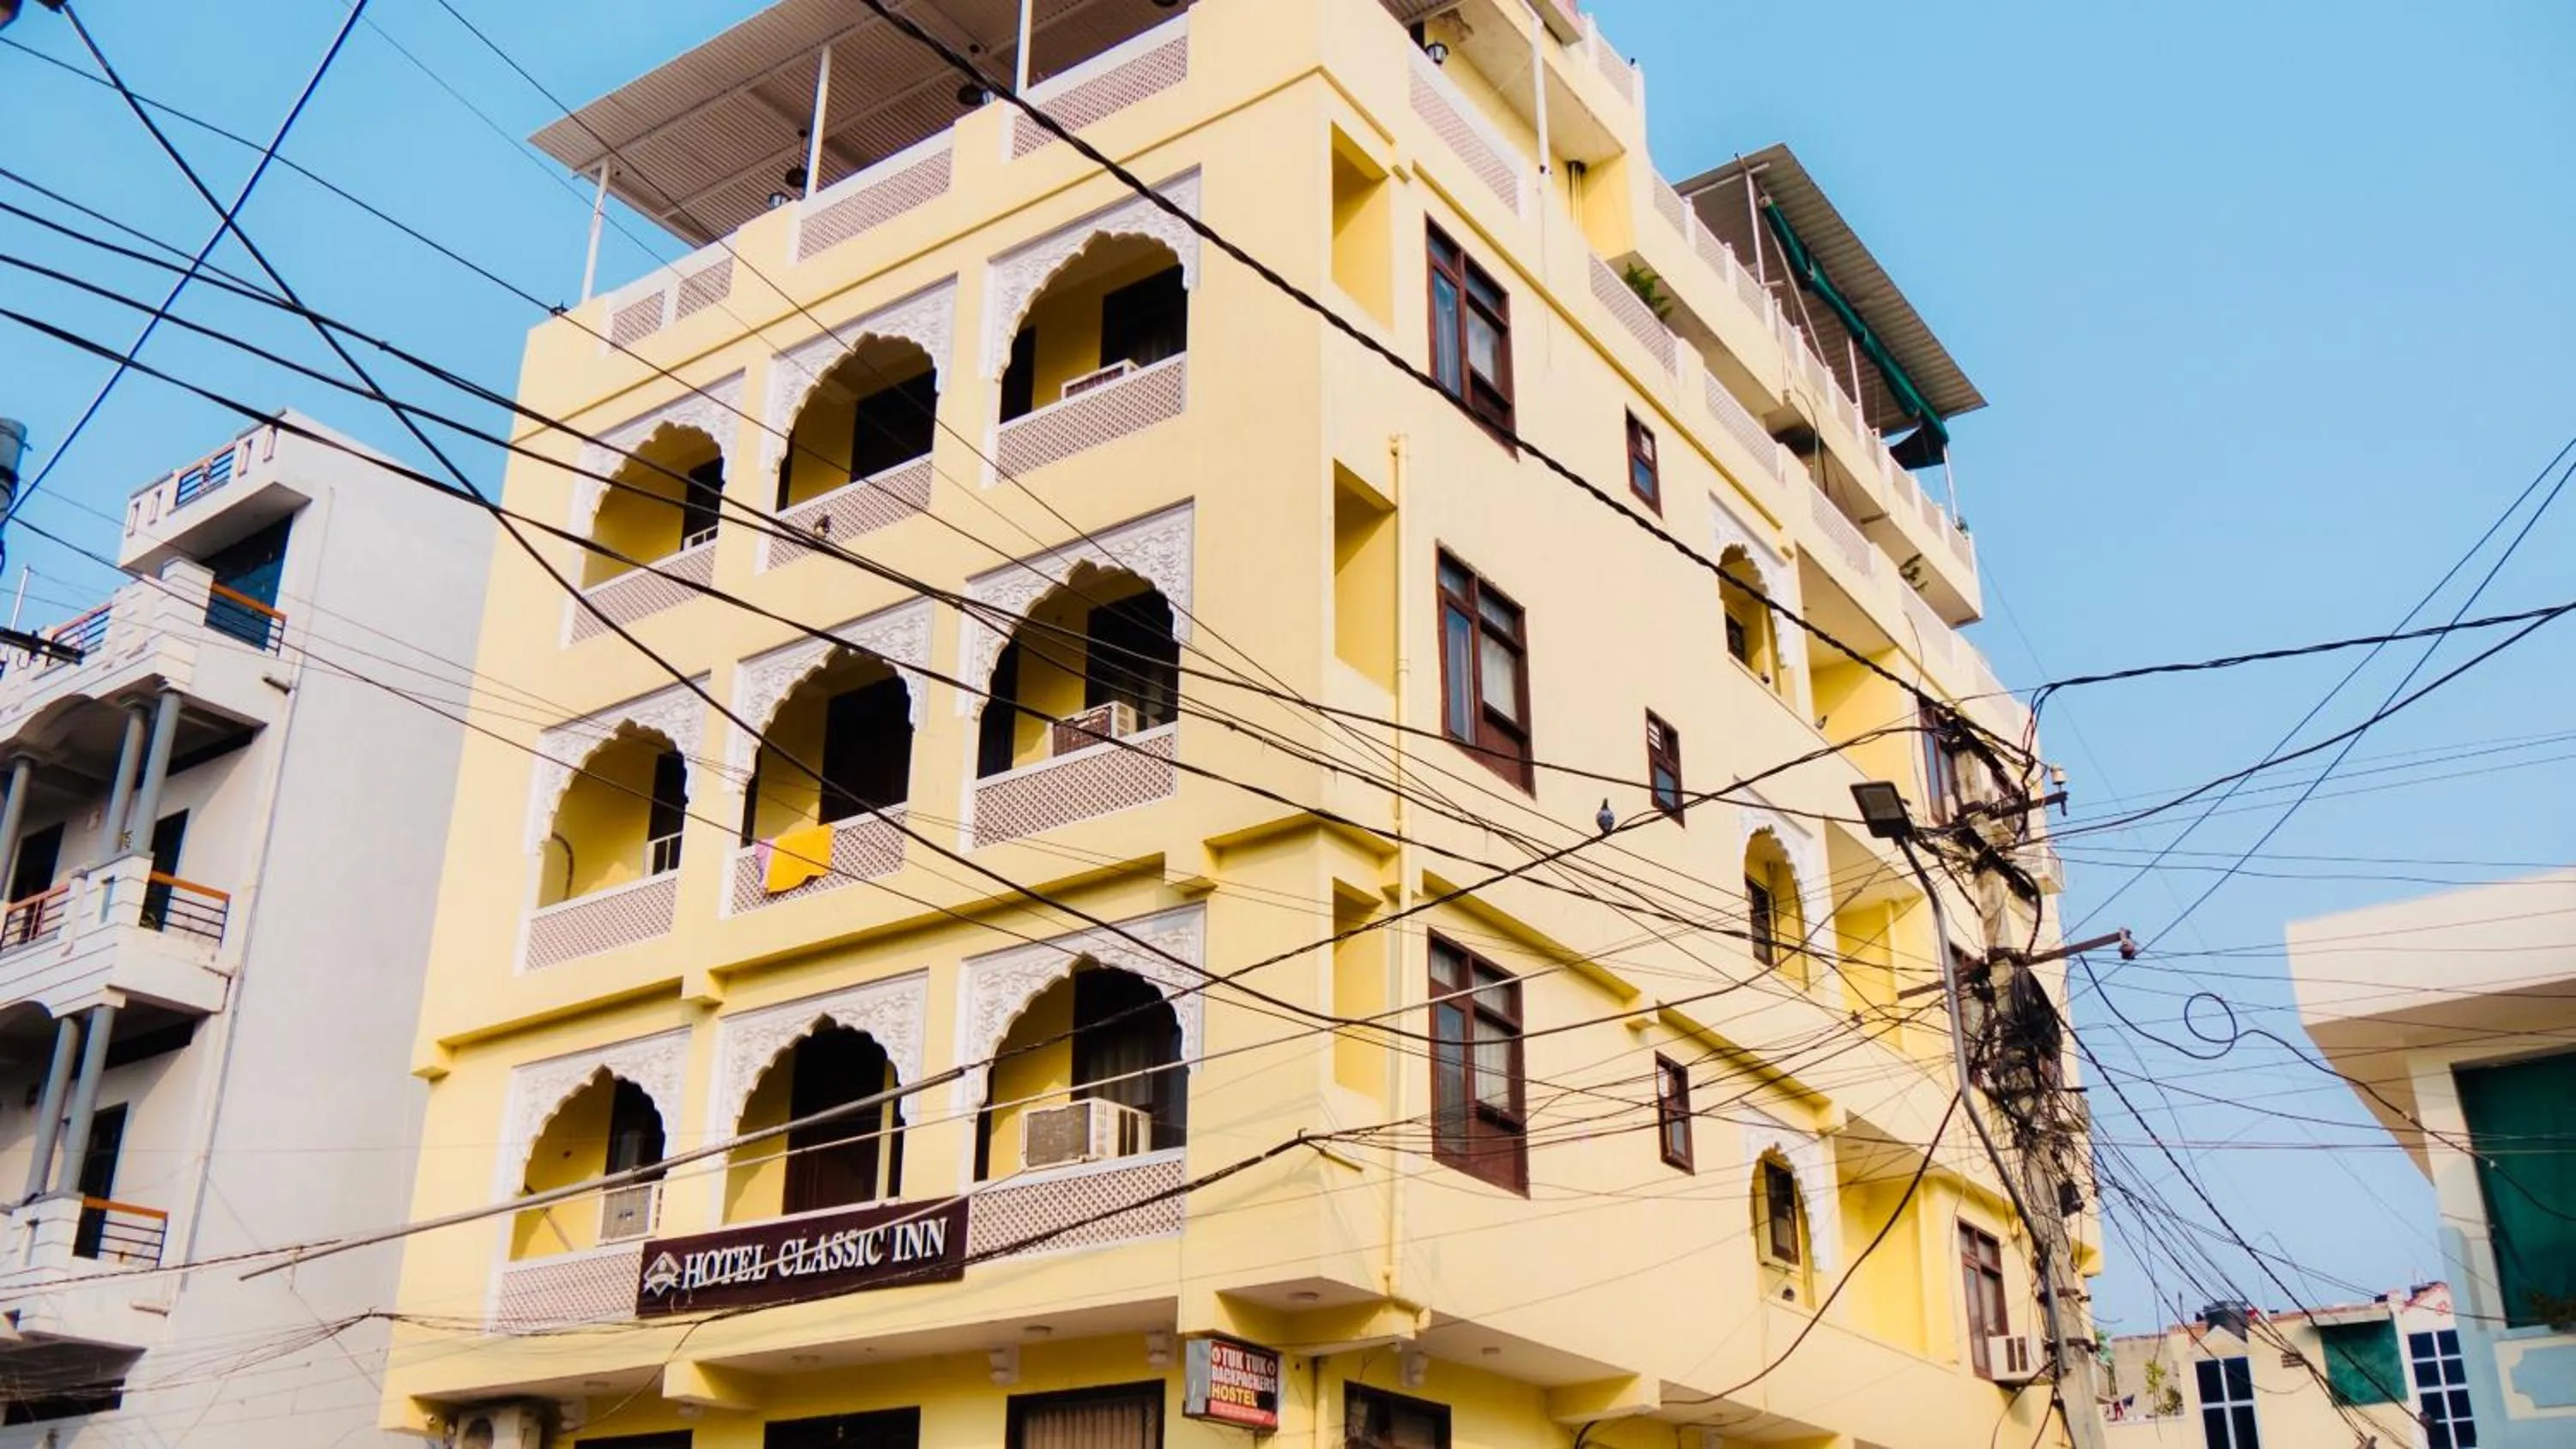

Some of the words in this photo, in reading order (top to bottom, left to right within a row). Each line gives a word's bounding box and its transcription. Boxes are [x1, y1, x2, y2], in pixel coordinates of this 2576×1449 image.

[682, 1244, 768, 1289] HOTEL
[777, 1229, 886, 1276] CLASSIC
[893, 1217, 948, 1262] INN
[1221, 1347, 1244, 1370] TUK
[1245, 1353, 1267, 1373] TUK
[1212, 1365, 1276, 1392] BACKPACKERS
[1212, 1383, 1258, 1407] HOSTEL
